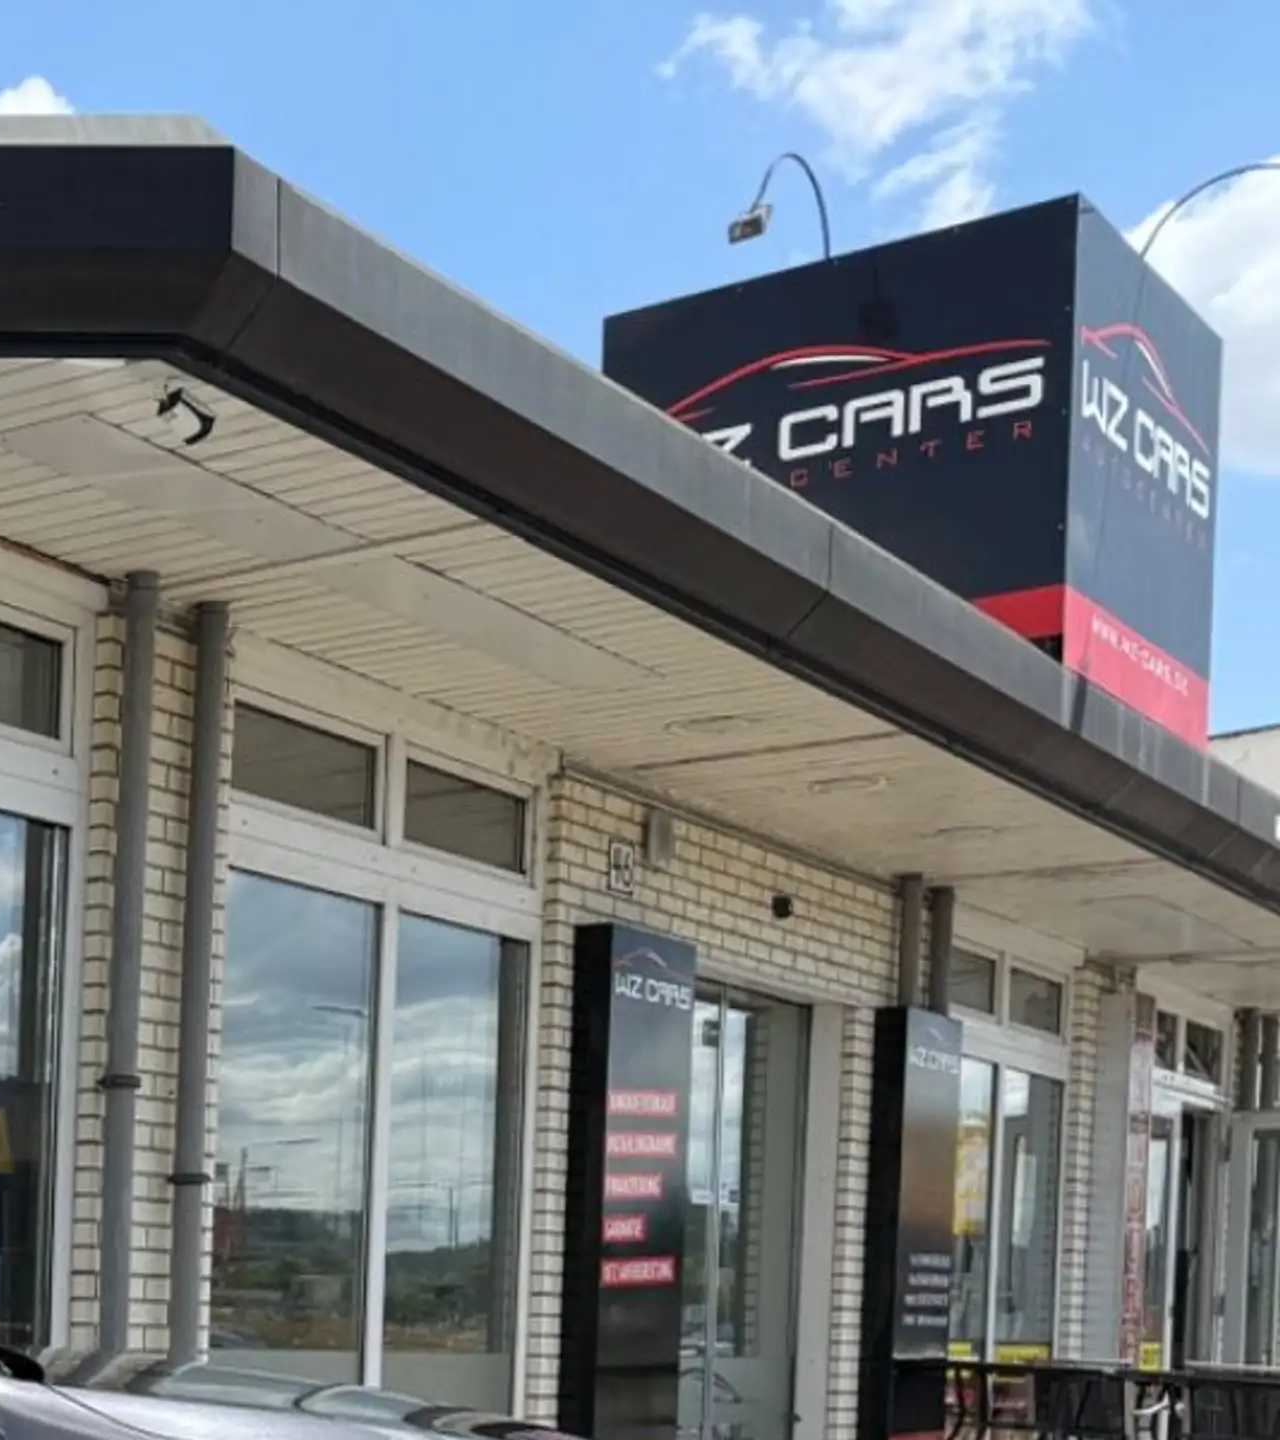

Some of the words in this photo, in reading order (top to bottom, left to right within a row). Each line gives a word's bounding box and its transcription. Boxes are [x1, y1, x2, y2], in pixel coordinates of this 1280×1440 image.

[700, 423, 753, 467] Z
[777, 356, 1045, 461] CARS
[1082, 359, 1129, 452] WZ
[1134, 408, 1211, 519] CARS
[614, 972, 643, 1000] WZ
[645, 979, 692, 1010] CARS
